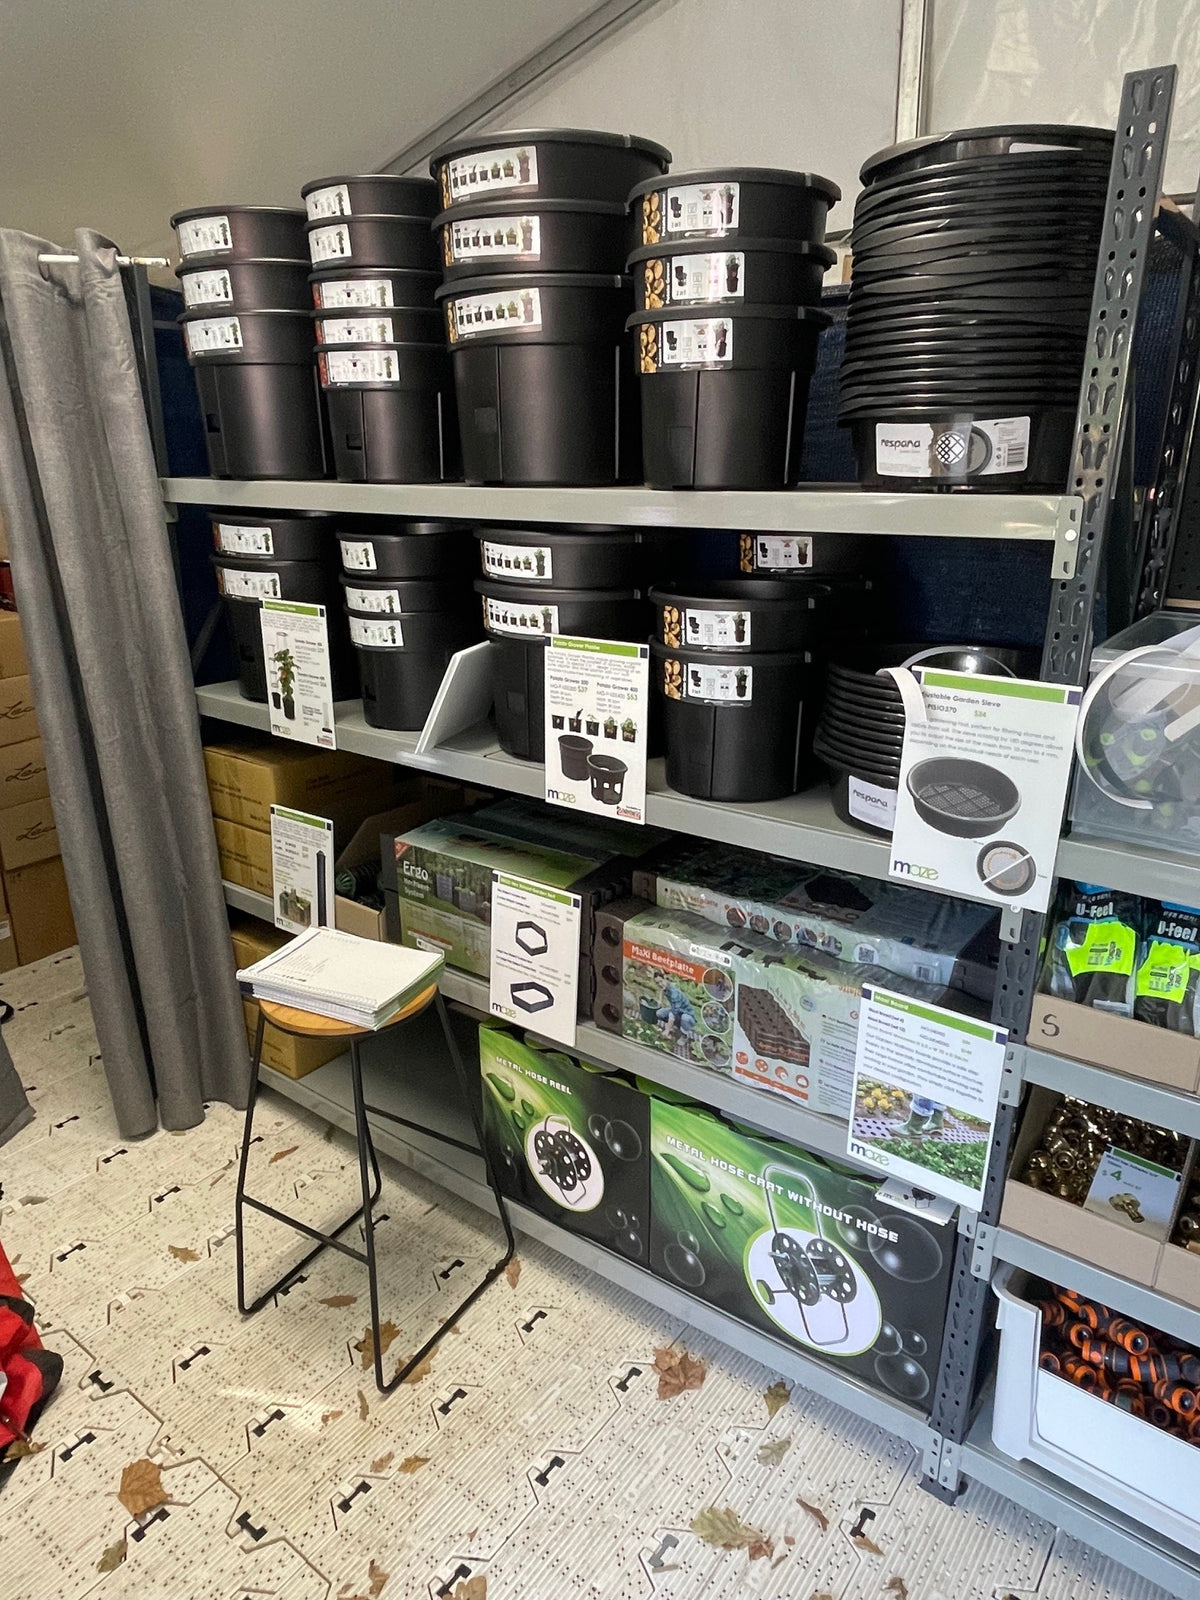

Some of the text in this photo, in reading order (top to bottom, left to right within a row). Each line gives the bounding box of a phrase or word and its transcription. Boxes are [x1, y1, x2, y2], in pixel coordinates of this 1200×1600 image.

[880, 438, 921, 451] respana
[952, 695, 980, 705] Garden
[981, 698, 1002, 708] Sieve
[852, 788, 889, 808] respana
[403, 860, 429, 881] Ergo
[893, 859, 940, 881] maze
[1075, 901, 1115, 918] U-Feel
[1157, 919, 1199, 943] U-Feel
[651, 952, 695, 975] Beetplatte
[1041, 1013, 1061, 1037] S
[495, 1055, 572, 1095] METAL HOSE REEL
[850, 1140, 891, 1167] maze
[666, 1134, 706, 1162] METAL
[710, 1156, 745, 1178] HOSE
[747, 1171, 784, 1196] CART
[787, 1189, 854, 1226] WITHOUT
[855, 1218, 900, 1243] HOSE
